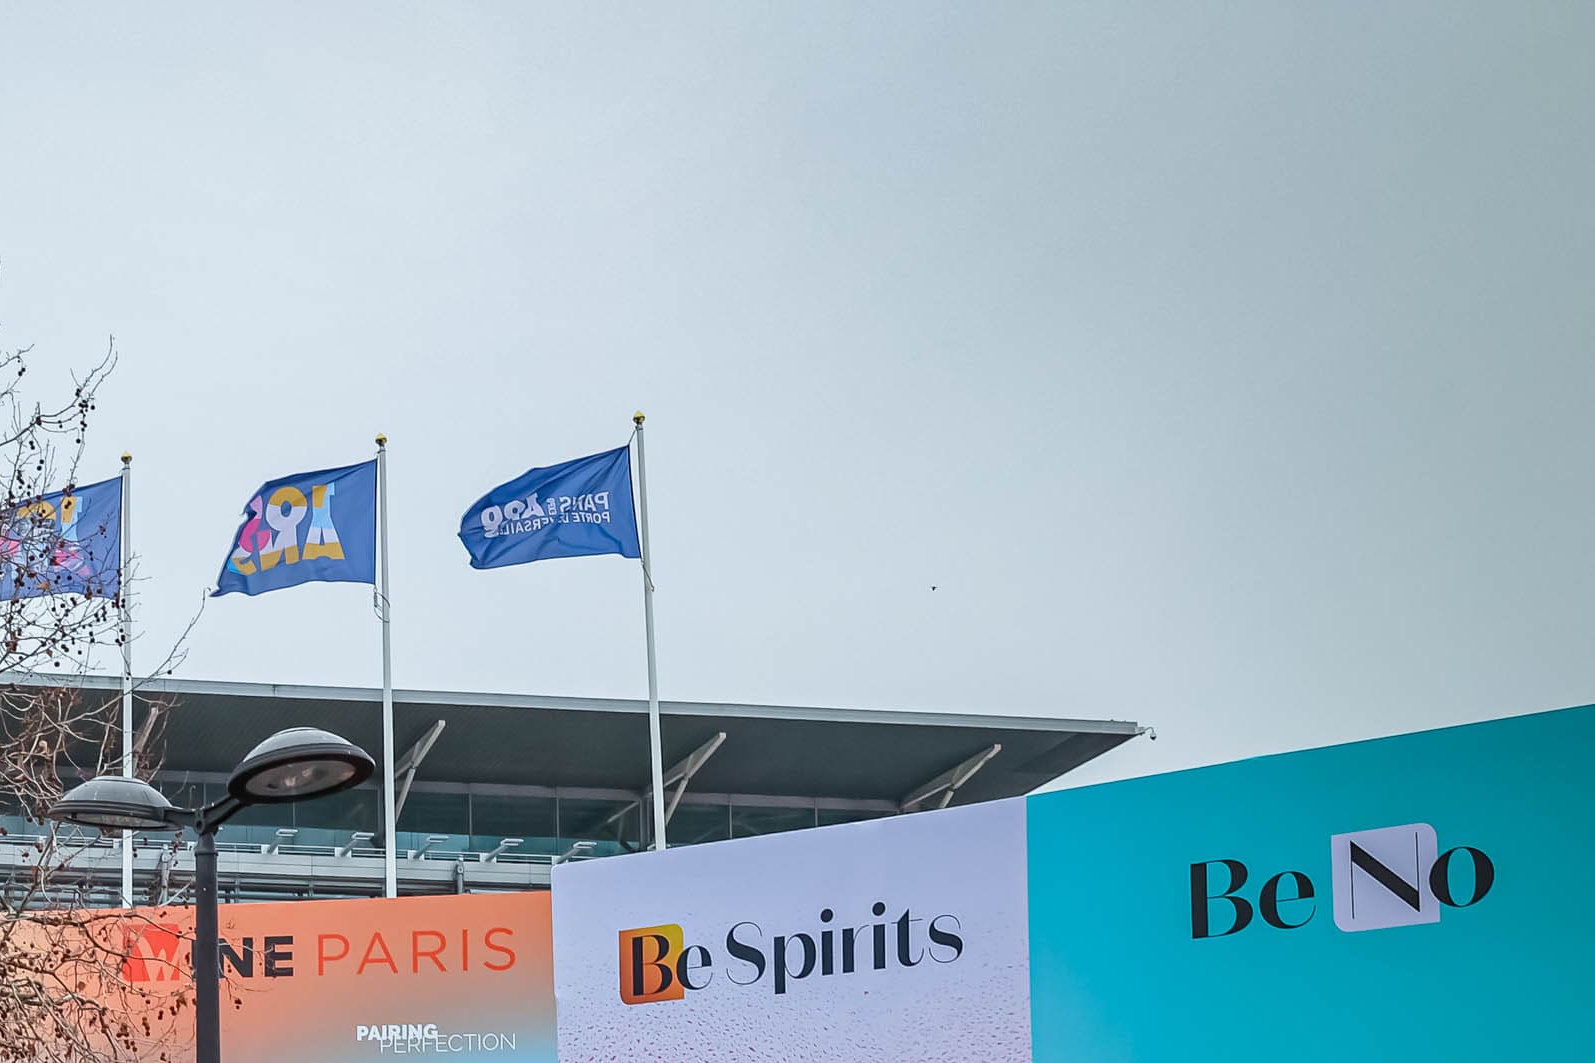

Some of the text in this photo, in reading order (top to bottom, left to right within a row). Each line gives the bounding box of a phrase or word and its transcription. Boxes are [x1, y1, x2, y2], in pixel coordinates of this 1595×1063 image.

[1189, 831, 1495, 940] Be No
[123, 923, 517, 981] WNE PARIS
[631, 901, 964, 997] Be Spirits
[356, 1023, 438, 1042] PAIRING
[380, 1032, 517, 1056] PERFECTION
